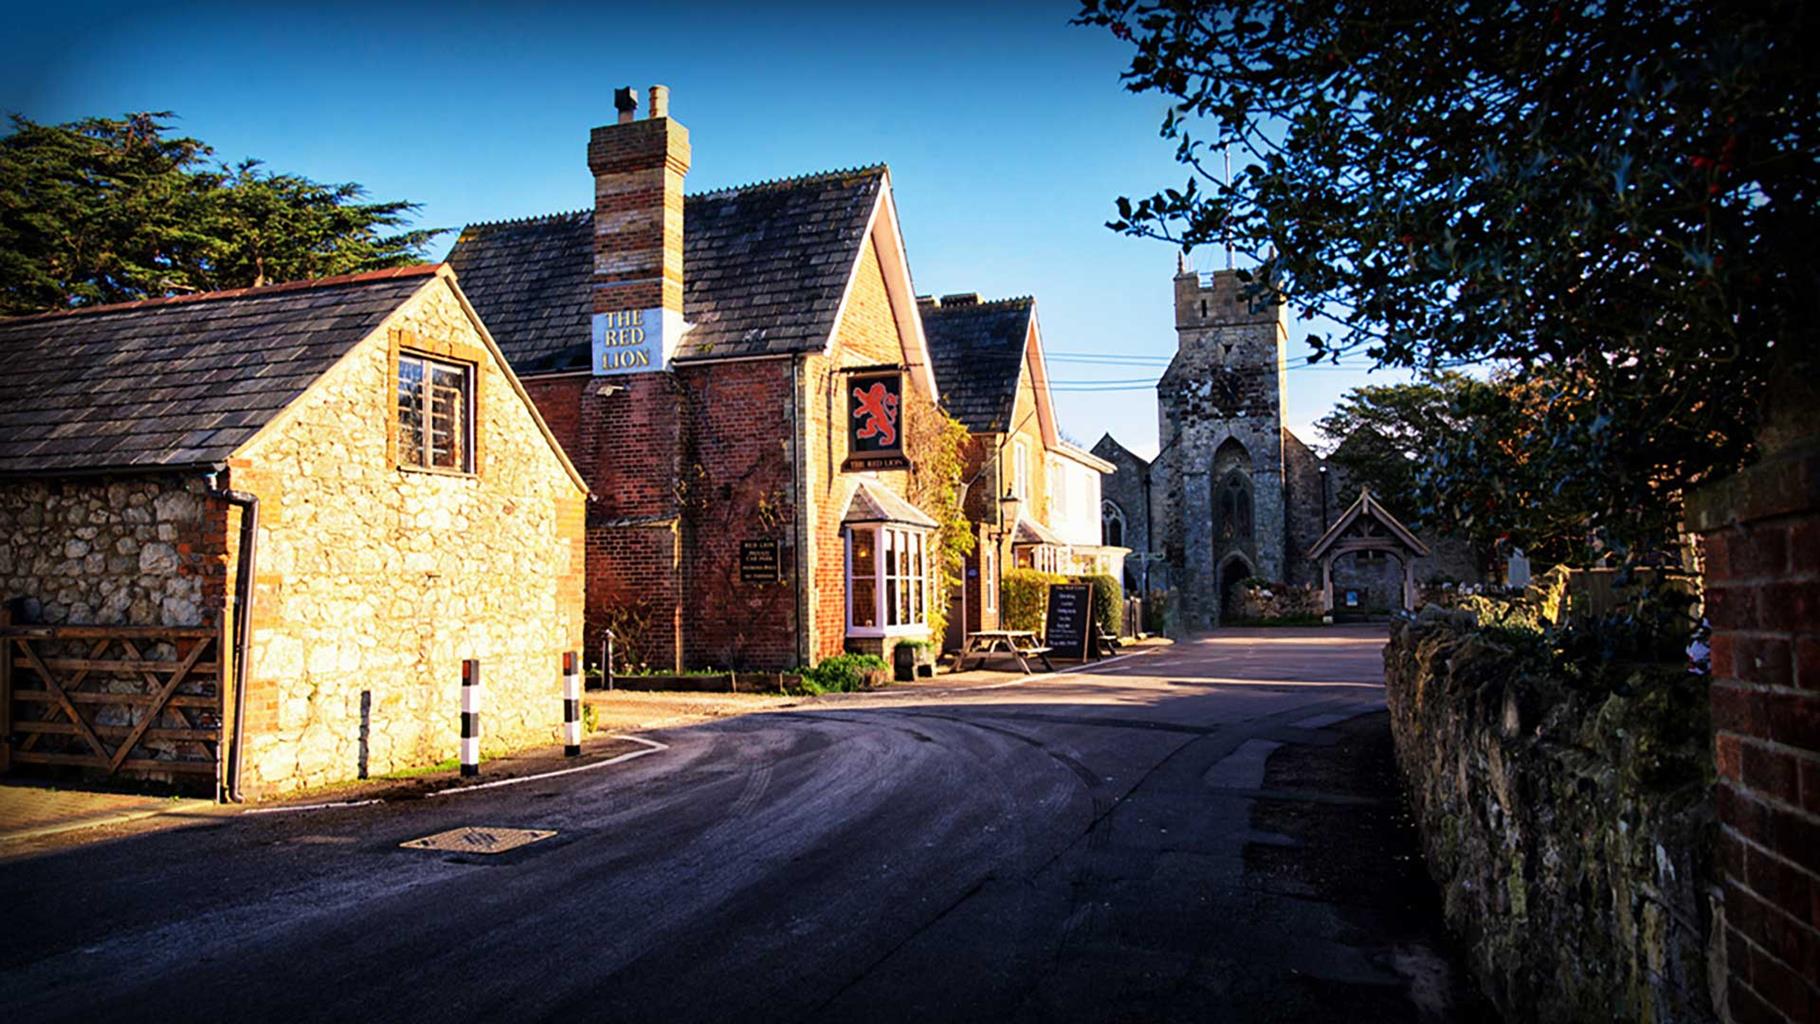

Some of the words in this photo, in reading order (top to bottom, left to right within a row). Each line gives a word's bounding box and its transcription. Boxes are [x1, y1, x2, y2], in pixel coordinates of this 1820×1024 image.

[606, 309, 644, 328] THE
[604, 327, 646, 347] RED
[602, 348, 650, 370] LION
[850, 460, 865, 469] THE
[867, 459, 883, 468] RED
[884, 459, 903, 467] LION
